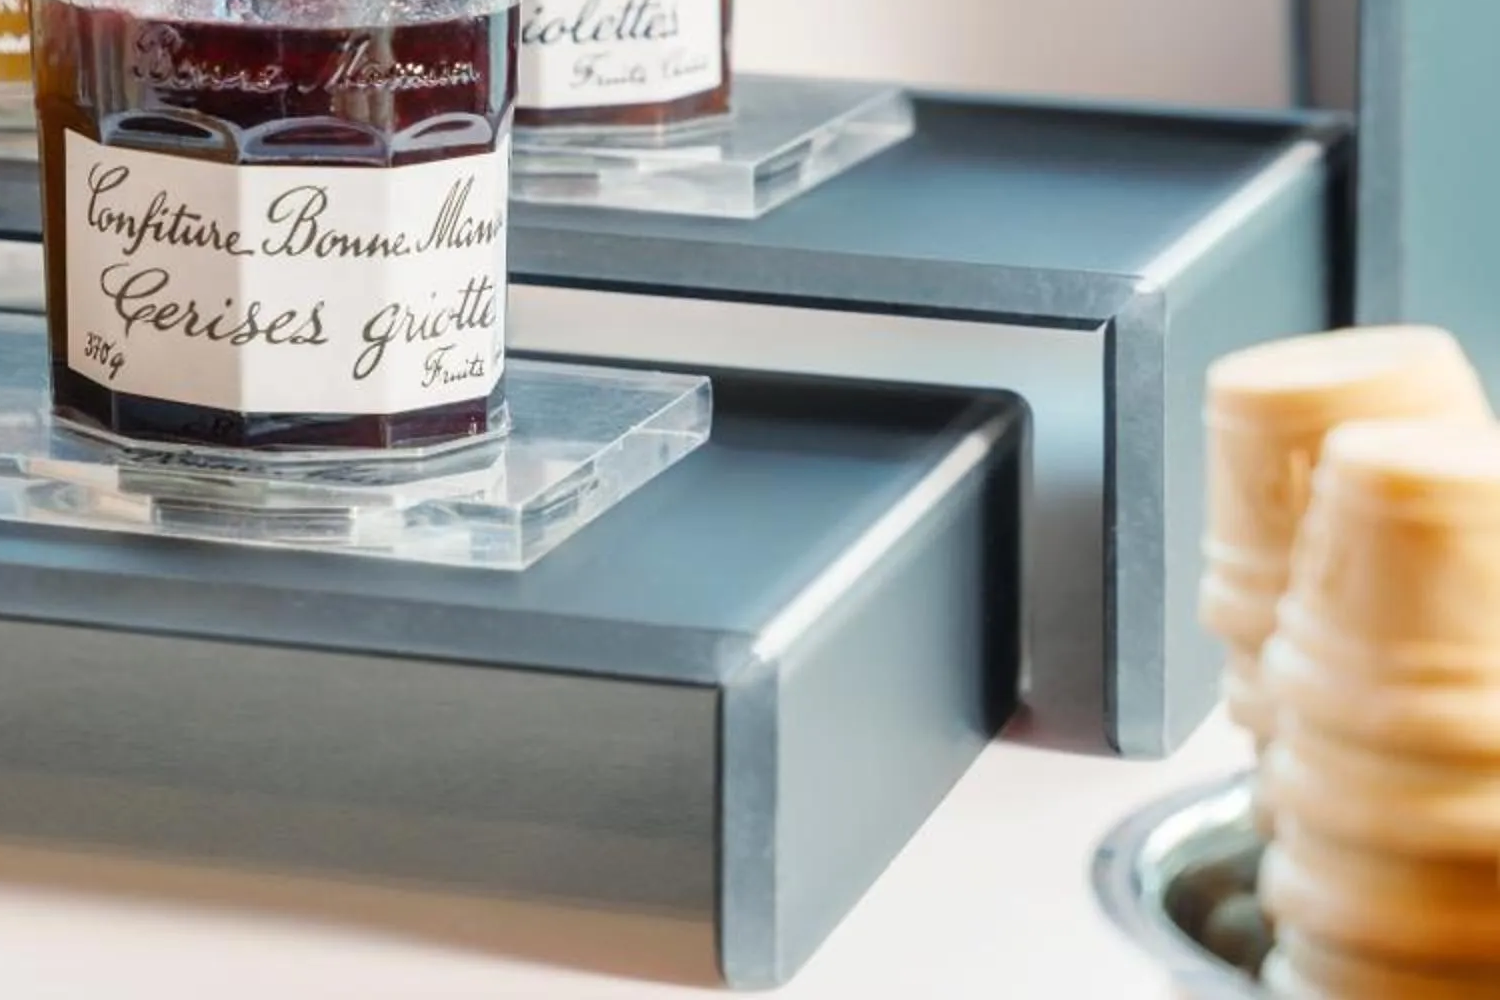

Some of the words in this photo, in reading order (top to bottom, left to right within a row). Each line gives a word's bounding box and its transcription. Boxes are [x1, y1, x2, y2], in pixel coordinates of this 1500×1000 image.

[86, 162, 255, 256] Confiture
[262, 185, 411, 258] Bonne
[415, 174, 503, 253] Mam
[100, 263, 329, 346] Cerises
[353, 274, 497, 381] griotte
[421, 343, 485, 389] Fruits
